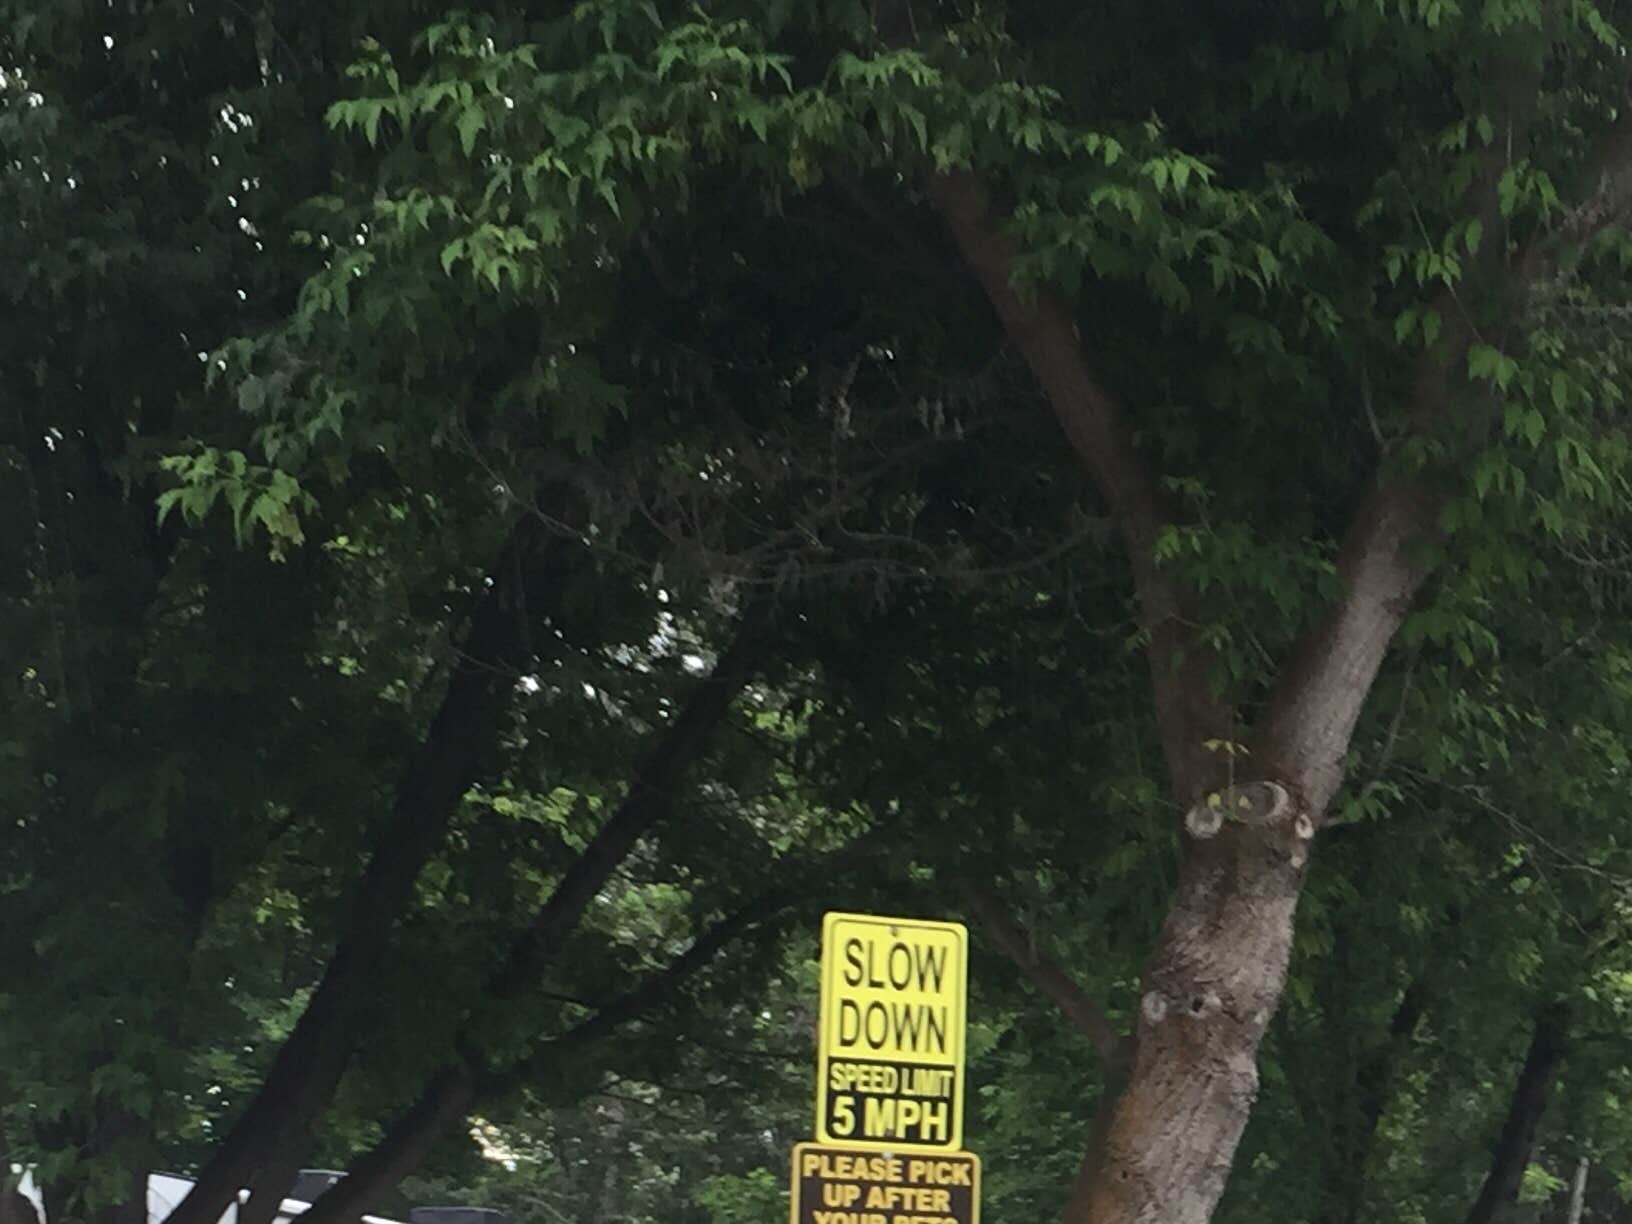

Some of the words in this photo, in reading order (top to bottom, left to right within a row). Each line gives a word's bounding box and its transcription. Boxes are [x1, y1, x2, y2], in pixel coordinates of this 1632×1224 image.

[843, 938, 947, 993] SLOW
[840, 998, 947, 1054] DOWN
[830, 1062, 899, 1094] SPEED
[901, 1067, 954, 1098] LIMIT
[832, 1096, 856, 1136] 5
[864, 1097, 948, 1141] MPH
[803, 1154, 903, 1183] PLEASE
[909, 1160, 971, 1187] PICK
[823, 1183, 861, 1208] UP
[865, 1186, 951, 1213] AFTER
